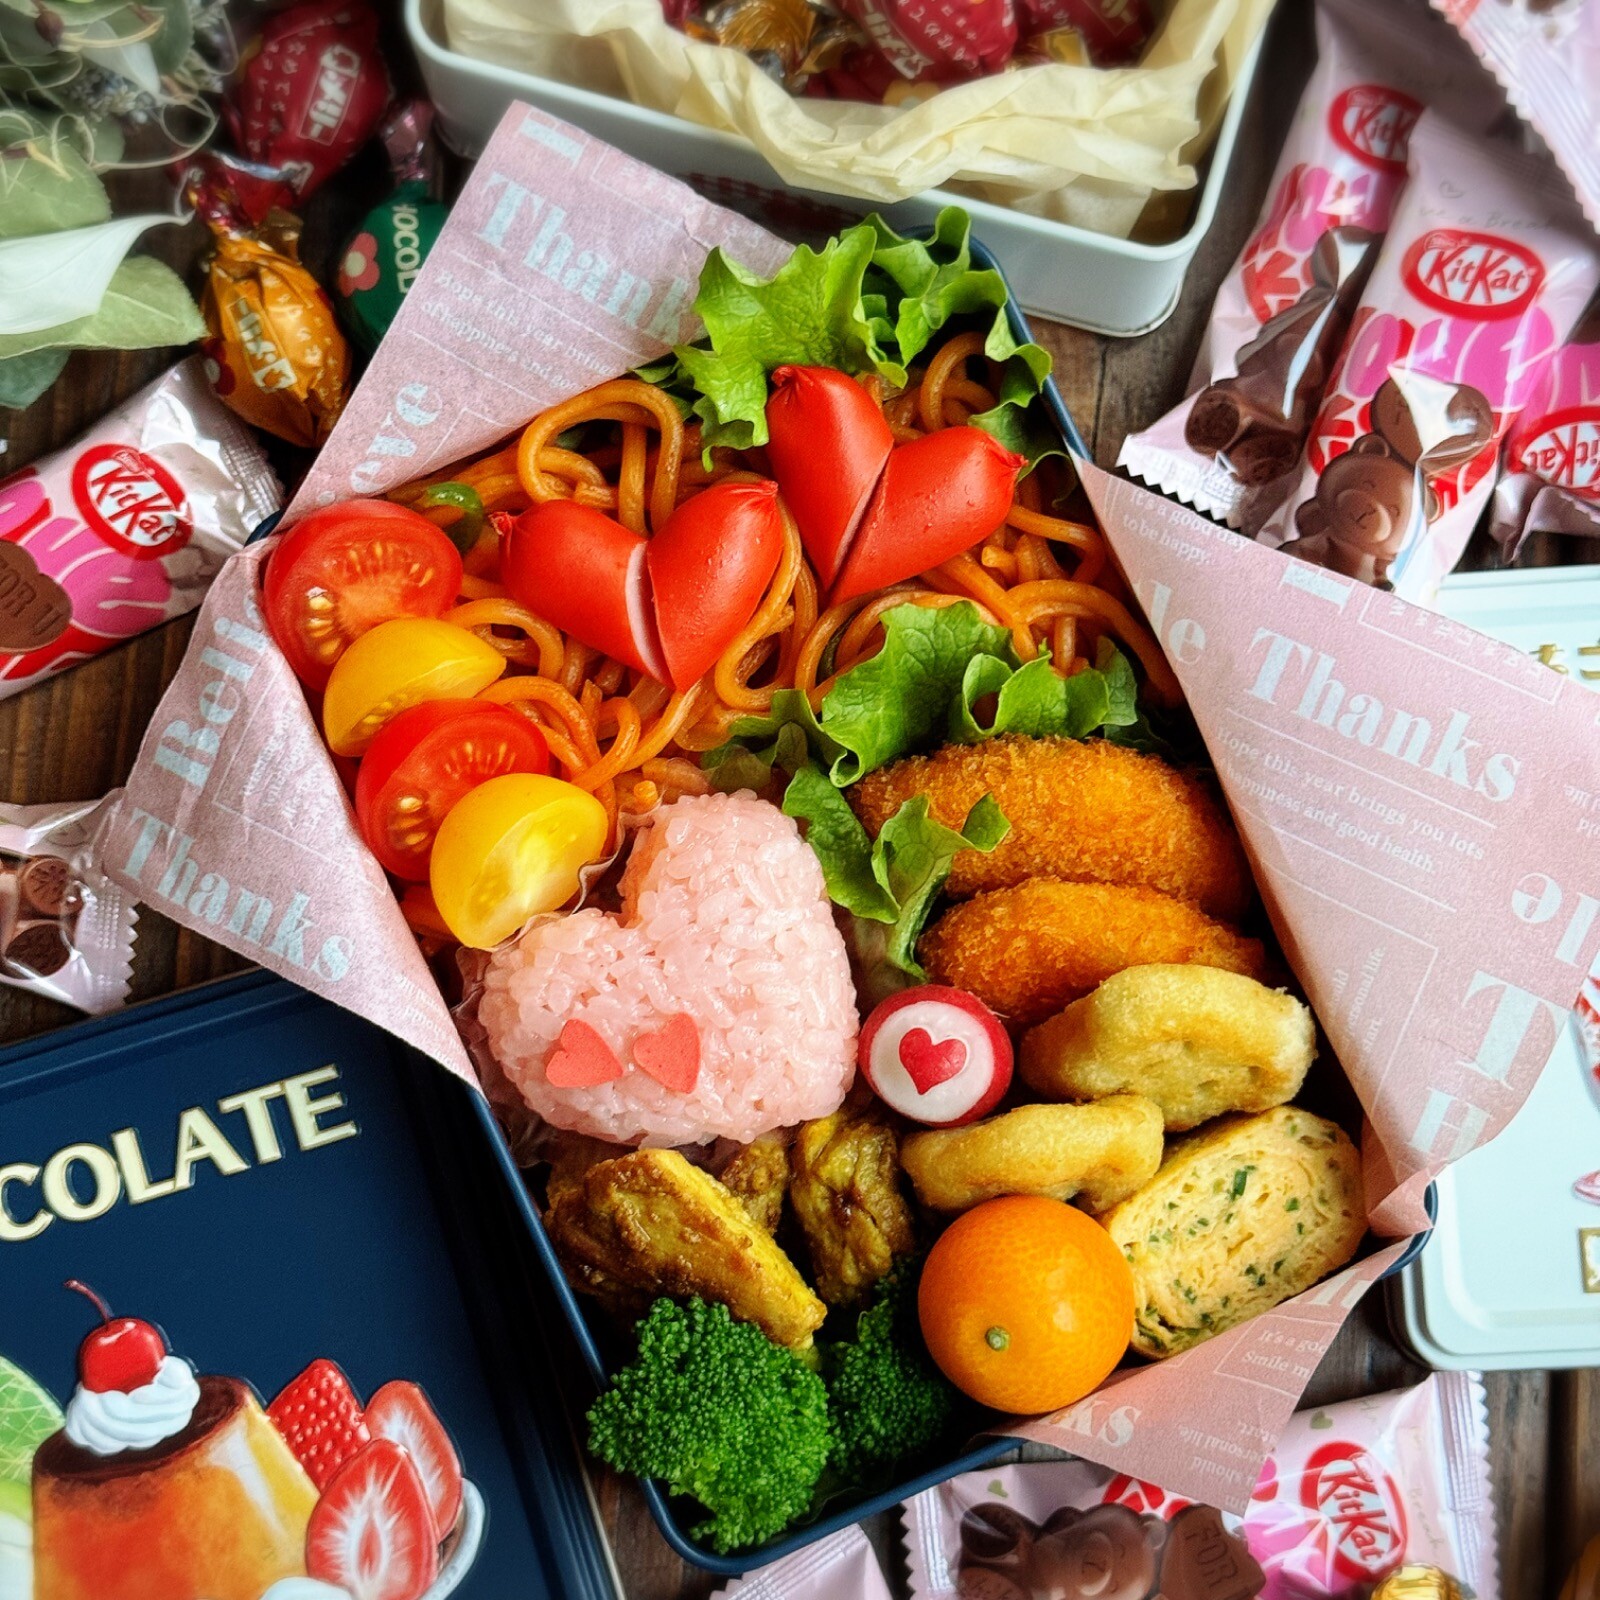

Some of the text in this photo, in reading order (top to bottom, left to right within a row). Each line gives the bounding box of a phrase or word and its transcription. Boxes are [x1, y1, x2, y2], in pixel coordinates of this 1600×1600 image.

[1424, 245, 1525, 304] KitKat
[521, 323, 563, 353] year
[318, 382, 443, 504] eve
[1528, 424, 1600, 485] itKat
[91, 467, 176, 542] KitKat
[1169, 509, 1213, 536] good
[1216, 524, 1249, 553] day
[1246, 626, 1524, 802] Thanks
[1302, 770, 1345, 797] year
[1348, 785, 1406, 826] brings
[1410, 816, 1445, 844] you
[1449, 832, 1485, 860] lots
[1302, 802, 1340, 829] and
[1337, 821, 1379, 848] good
[105, 806, 355, 984] Thanks
[0, 1063, 358, 1242] COLATE
[1242, 1351, 1290, 1372] Smile
[1319, 1469, 1391, 1562] KitKat
